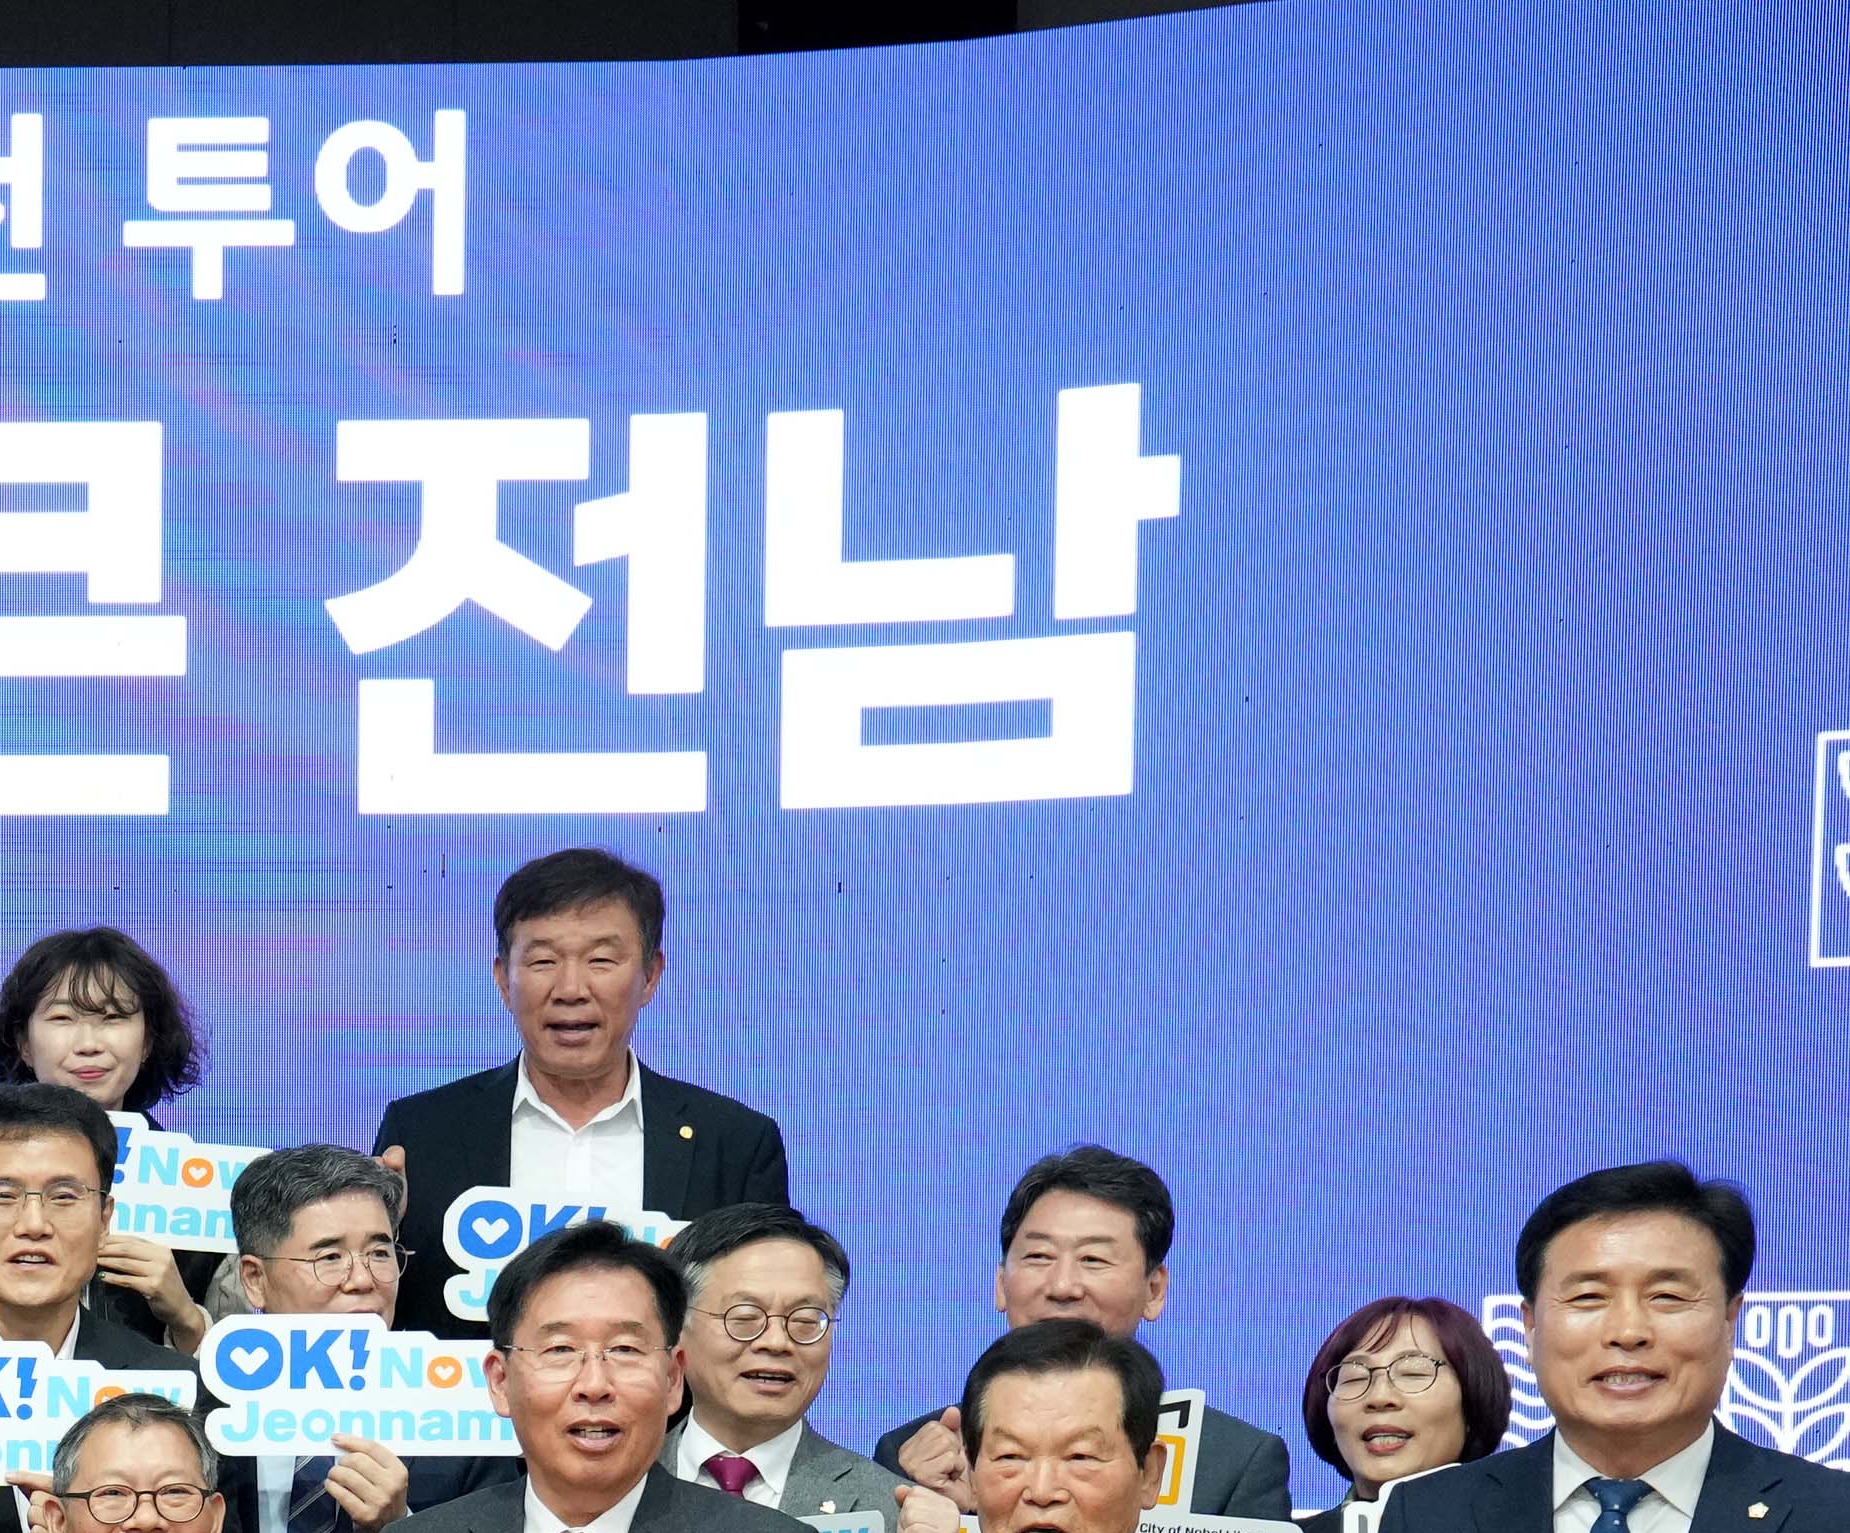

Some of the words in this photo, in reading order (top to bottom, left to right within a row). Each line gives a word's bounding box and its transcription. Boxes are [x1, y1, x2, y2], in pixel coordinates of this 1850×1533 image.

[124, 110, 465, 299] 투어
[326, 383, 1180, 814] 전남
[215, 1328, 370, 1391] OK!
[221, 1401, 513, 1442] Jeonnam
